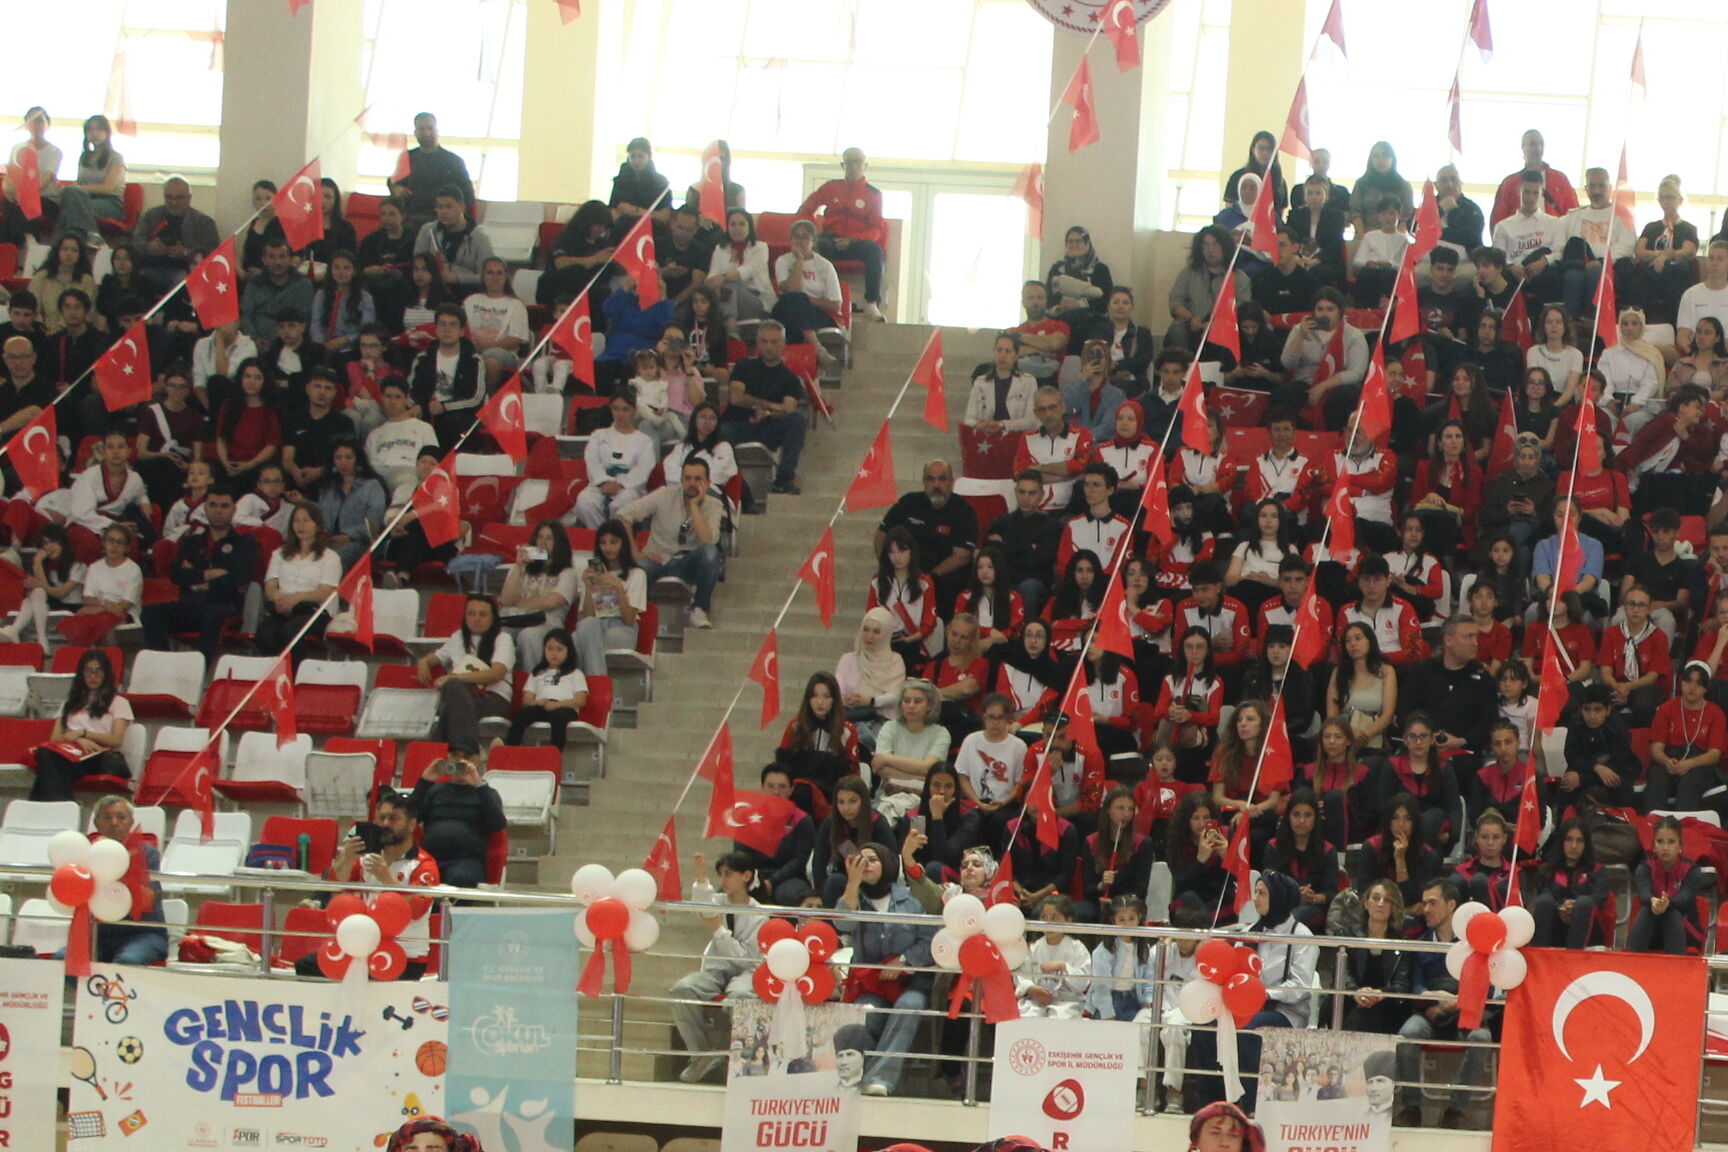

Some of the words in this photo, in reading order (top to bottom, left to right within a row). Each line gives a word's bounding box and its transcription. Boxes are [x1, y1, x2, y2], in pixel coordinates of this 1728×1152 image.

[186, 1040, 336, 1101] SPOR
[1115, 1053, 1124, 1061] VE
[756, 1120, 828, 1147] GÜCÜ
